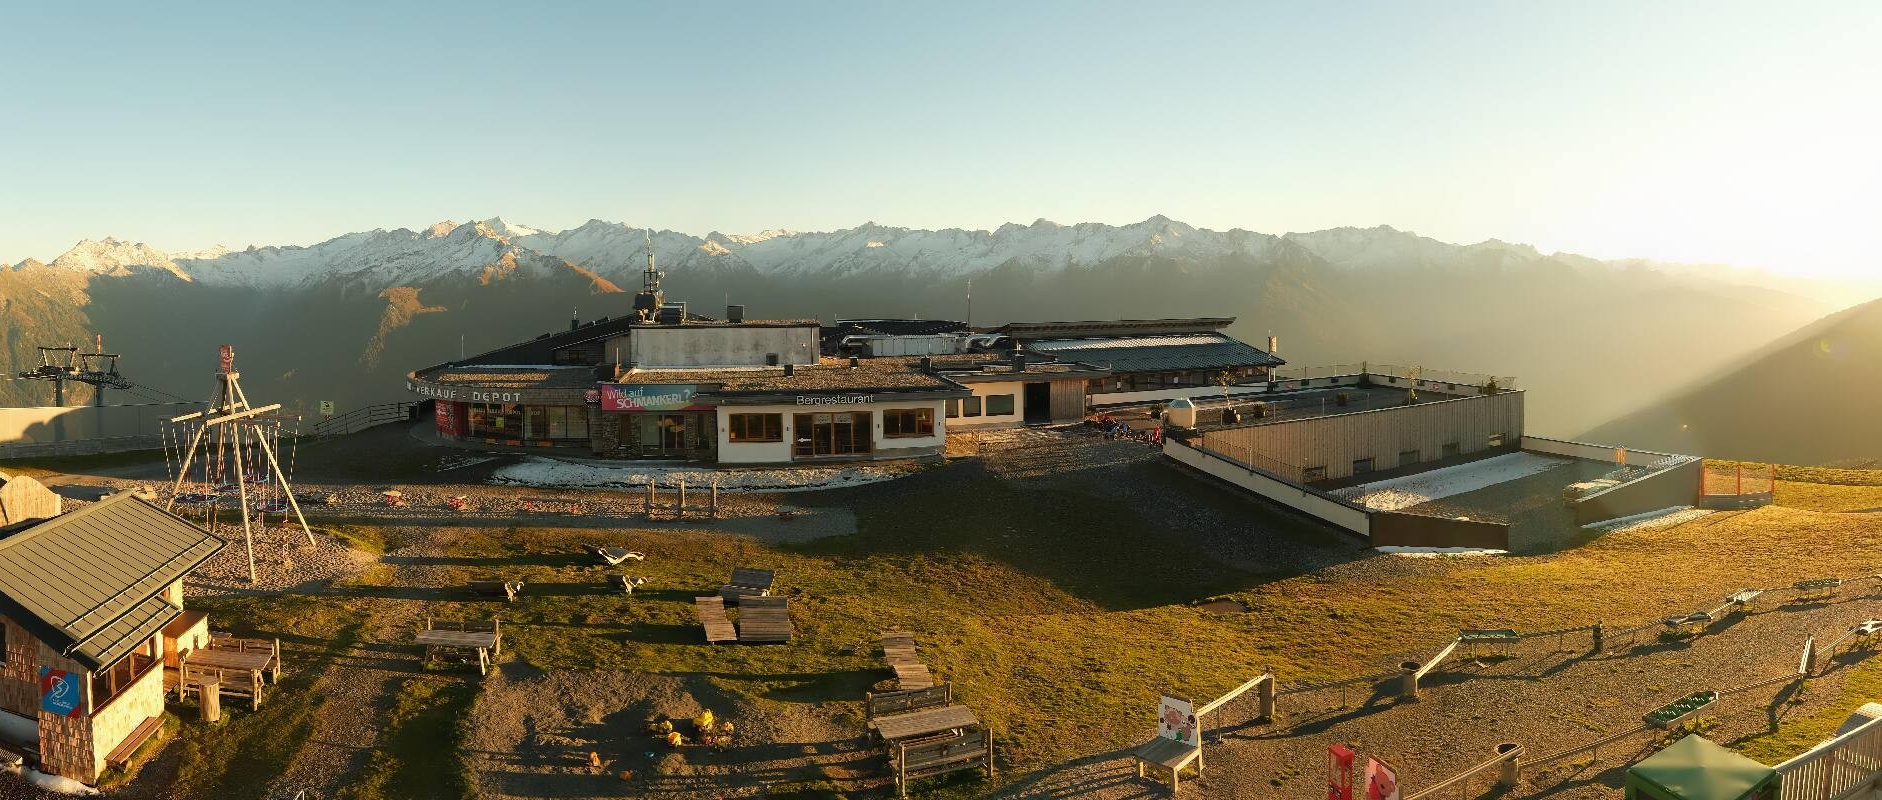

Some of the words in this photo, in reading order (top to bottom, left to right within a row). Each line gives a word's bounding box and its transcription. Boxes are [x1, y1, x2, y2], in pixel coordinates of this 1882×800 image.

[417, 386, 457, 399] VERKAUF
[473, 391, 521, 402] DEPOT
[607, 388, 627, 399] Wild
[629, 386, 644, 398] auf
[796, 394, 875, 406] Bergrestaurant
